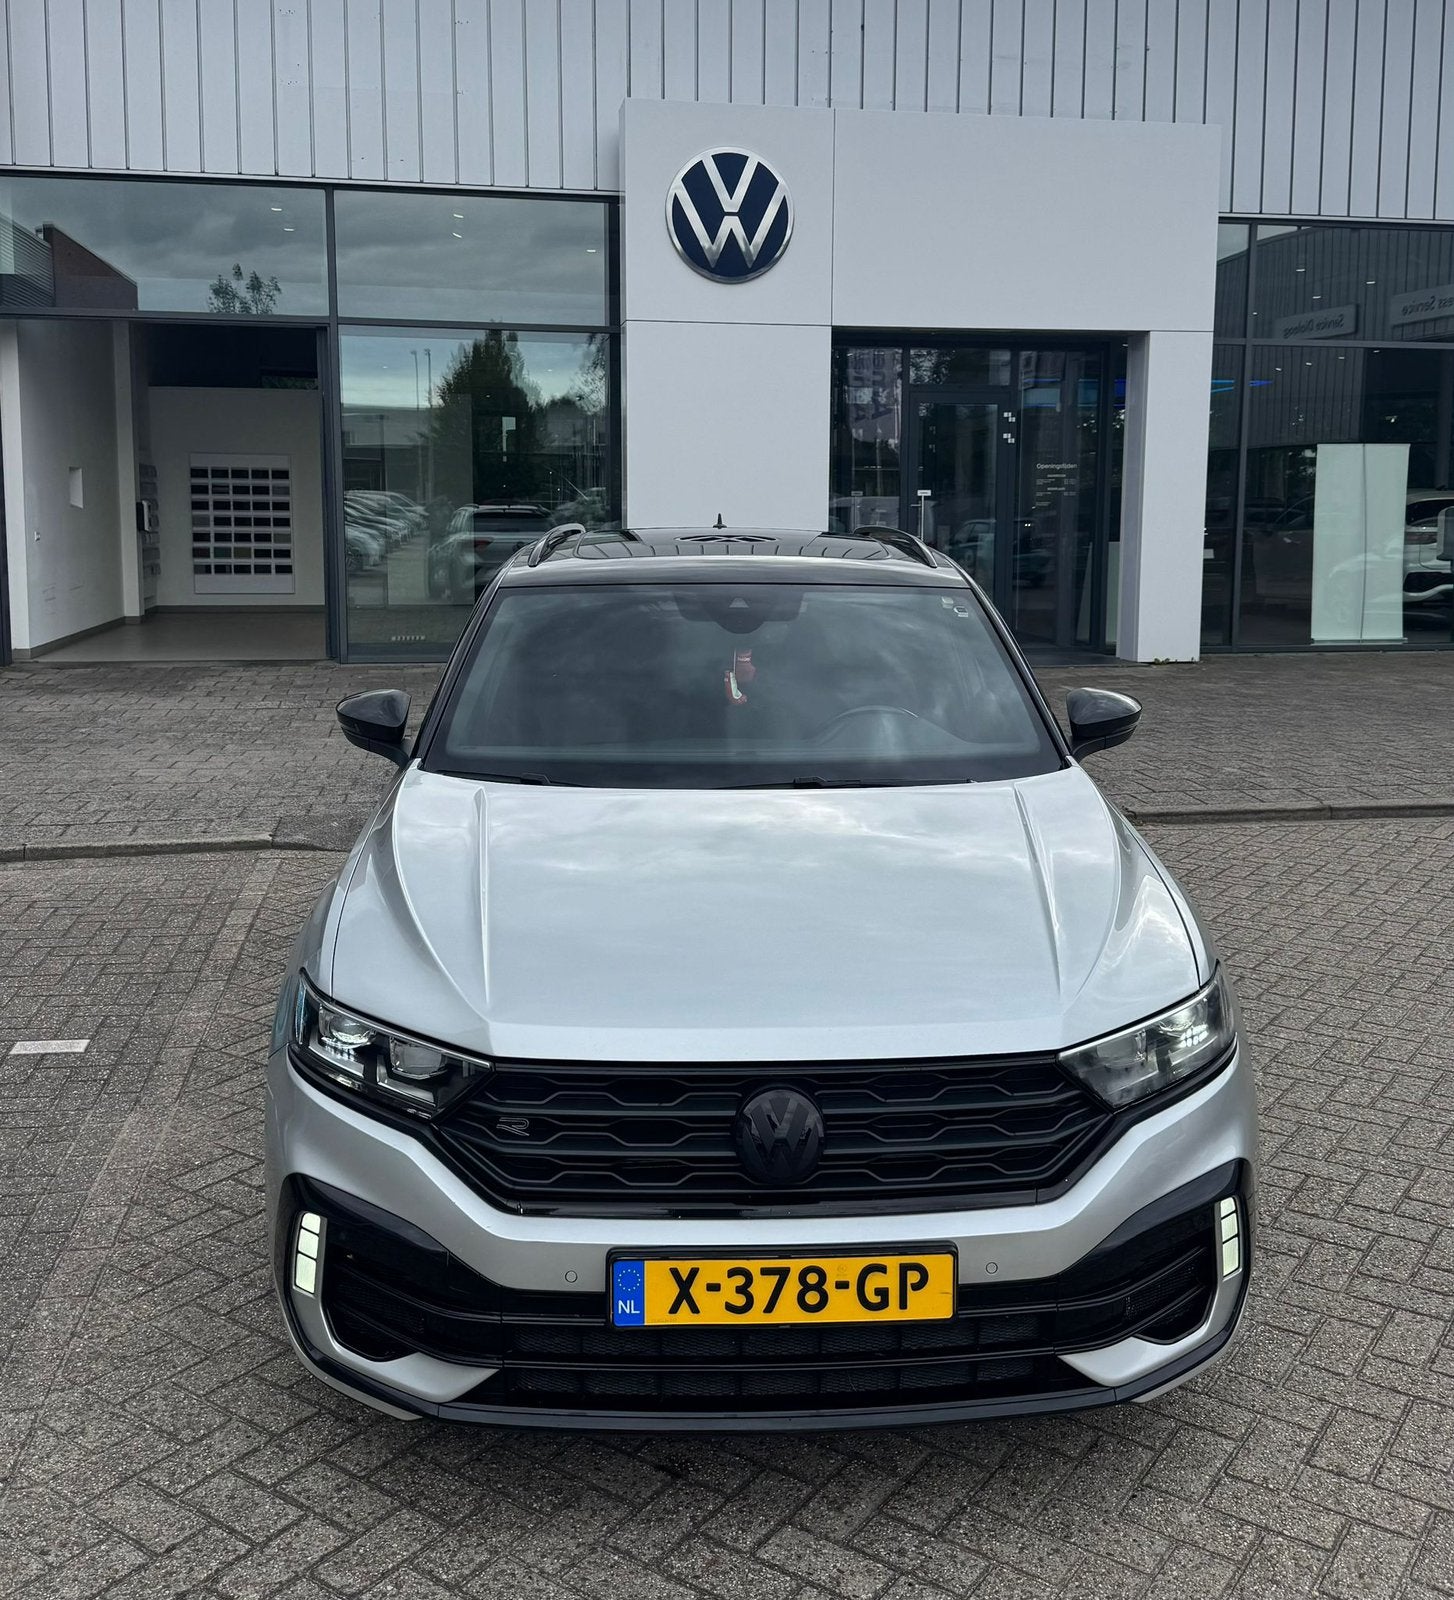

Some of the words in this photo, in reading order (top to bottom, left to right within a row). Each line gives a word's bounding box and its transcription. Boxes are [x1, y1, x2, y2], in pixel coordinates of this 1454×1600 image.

[668, 147, 793, 277] VW
[618, 1300, 641, 1314] NL
[668, 1262, 929, 1315] X-378-GP
